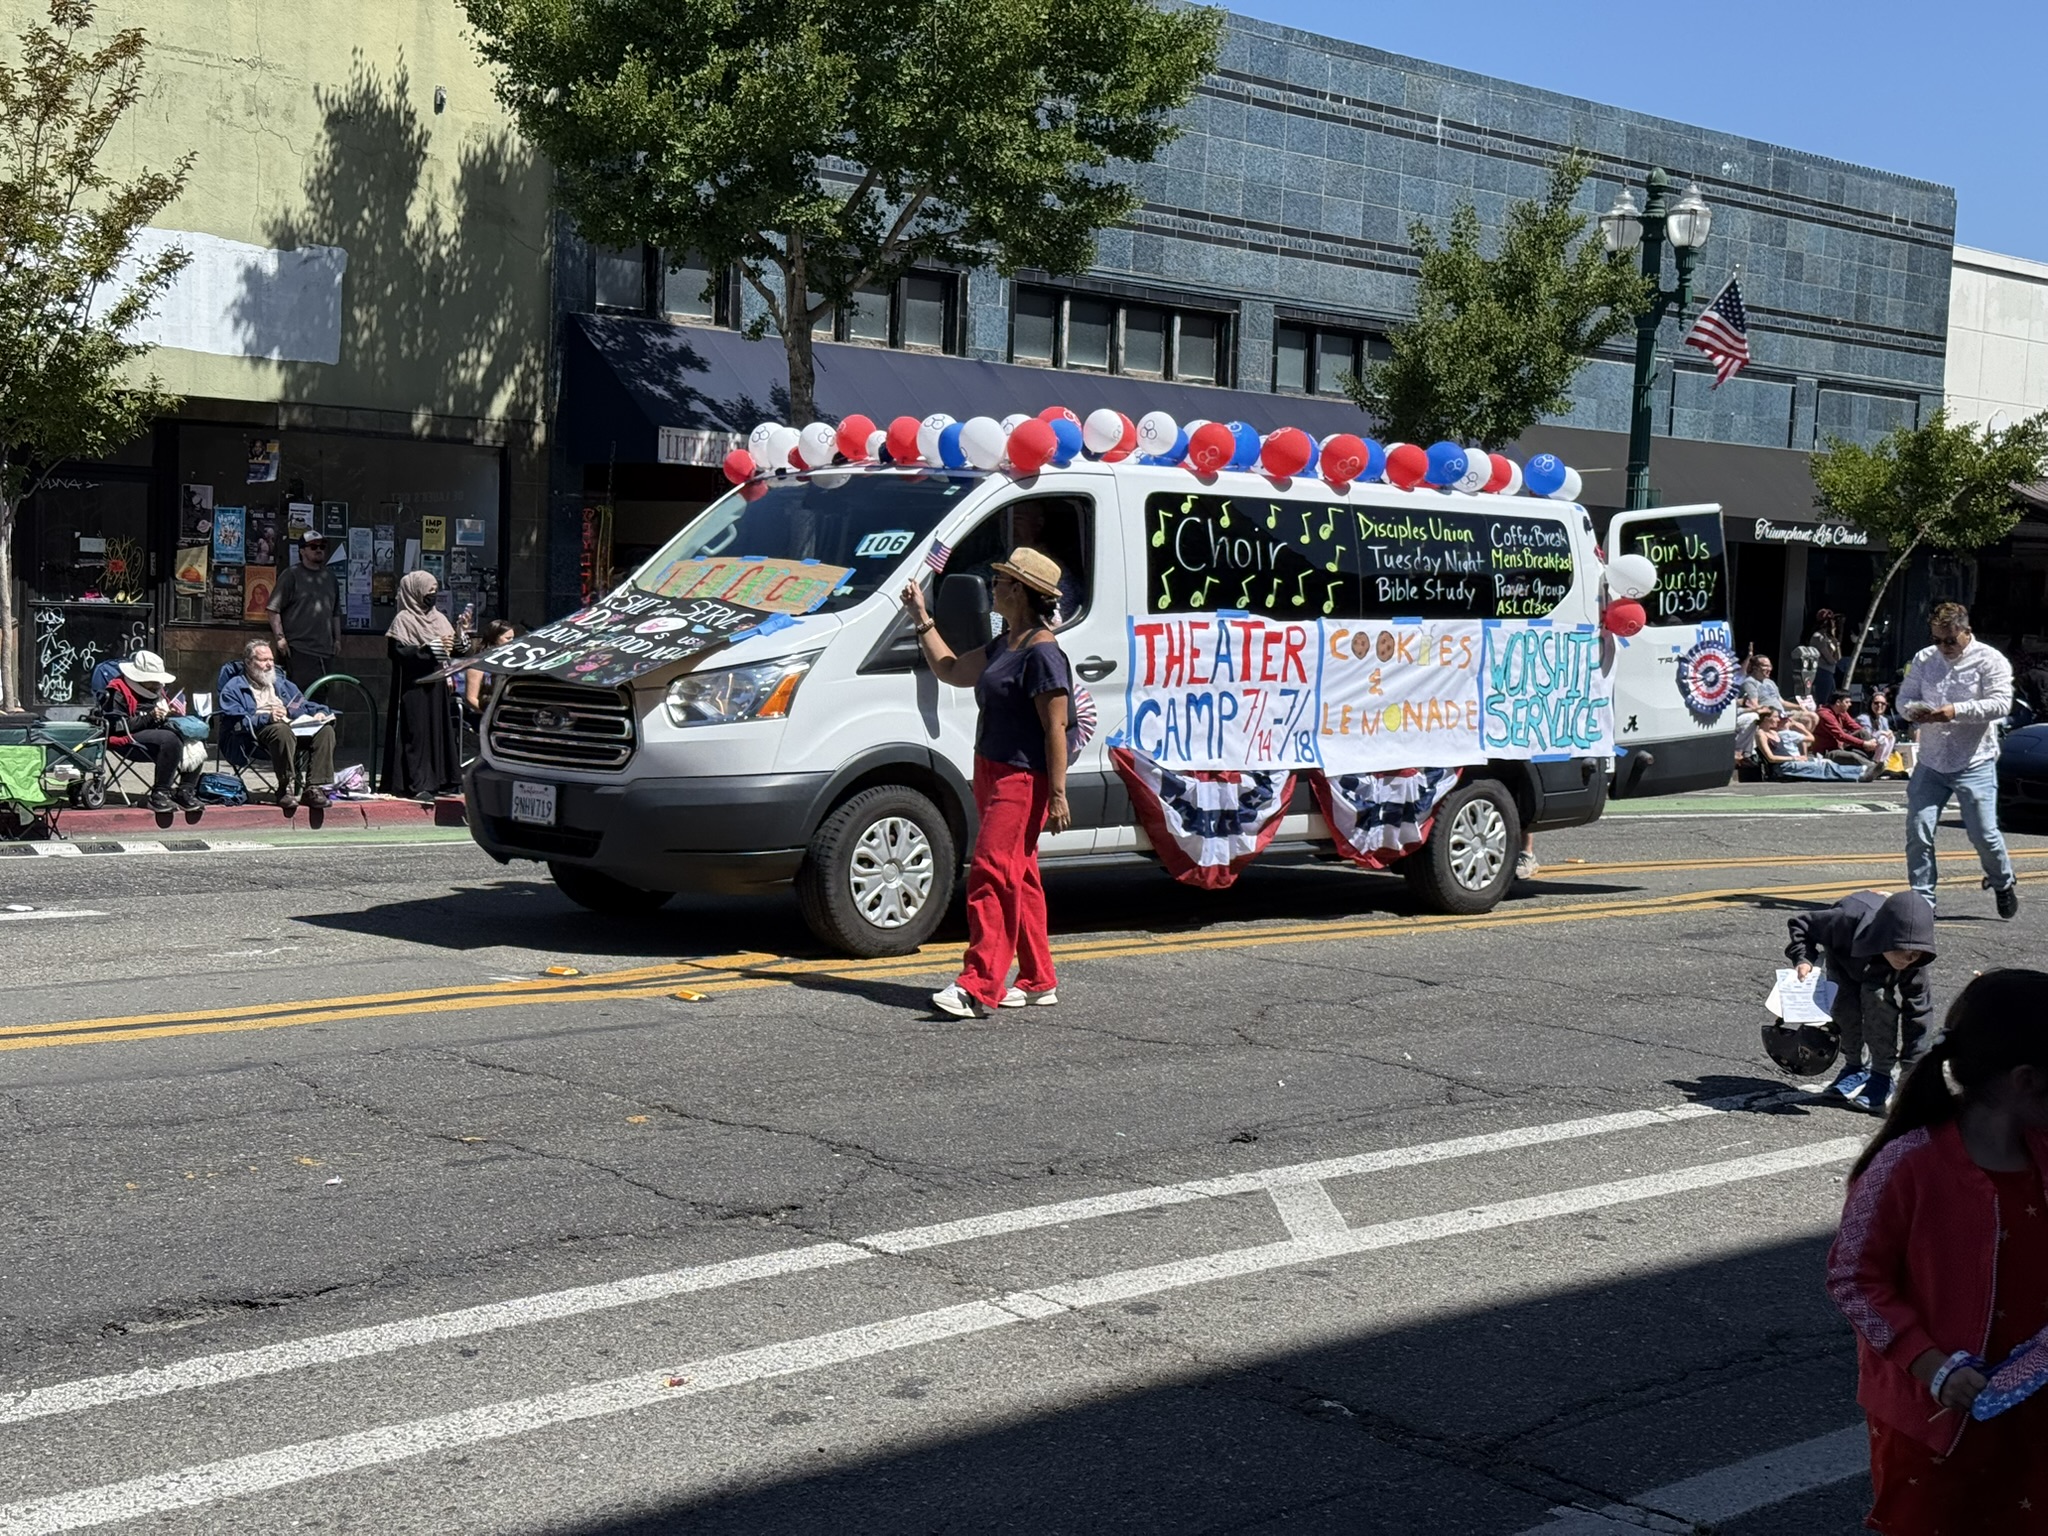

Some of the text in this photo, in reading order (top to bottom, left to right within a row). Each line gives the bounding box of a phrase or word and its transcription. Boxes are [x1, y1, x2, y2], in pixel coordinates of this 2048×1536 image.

[425, 519, 442, 527] IMP
[1356, 511, 1475, 547] Disciples Union
[1490, 522, 1568, 549] Coffee Break
[1755, 517, 1813, 544] Triumphant
[861, 535, 908, 553] 106
[1176, 516, 1288, 572] Choir
[1522, 546, 1573, 572] Breakfast
[1636, 533, 1711, 563] Join Us
[1367, 545, 1486, 578] Tuesday Night
[1375, 576, 1476, 610] Bible Study
[1494, 573, 1531, 602] Prayer
[1658, 589, 1709, 616] 10:30
[674, 600, 756, 629] SERVE
[1496, 598, 1554, 616] ASL Class
[1134, 619, 1308, 688] THEATER
[1486, 628, 1604, 700] WORSHIP
[1134, 690, 1239, 761] CAMP
[1321, 696, 1479, 736] LEMONADE
[1486, 694, 1609, 752] SERVICE
